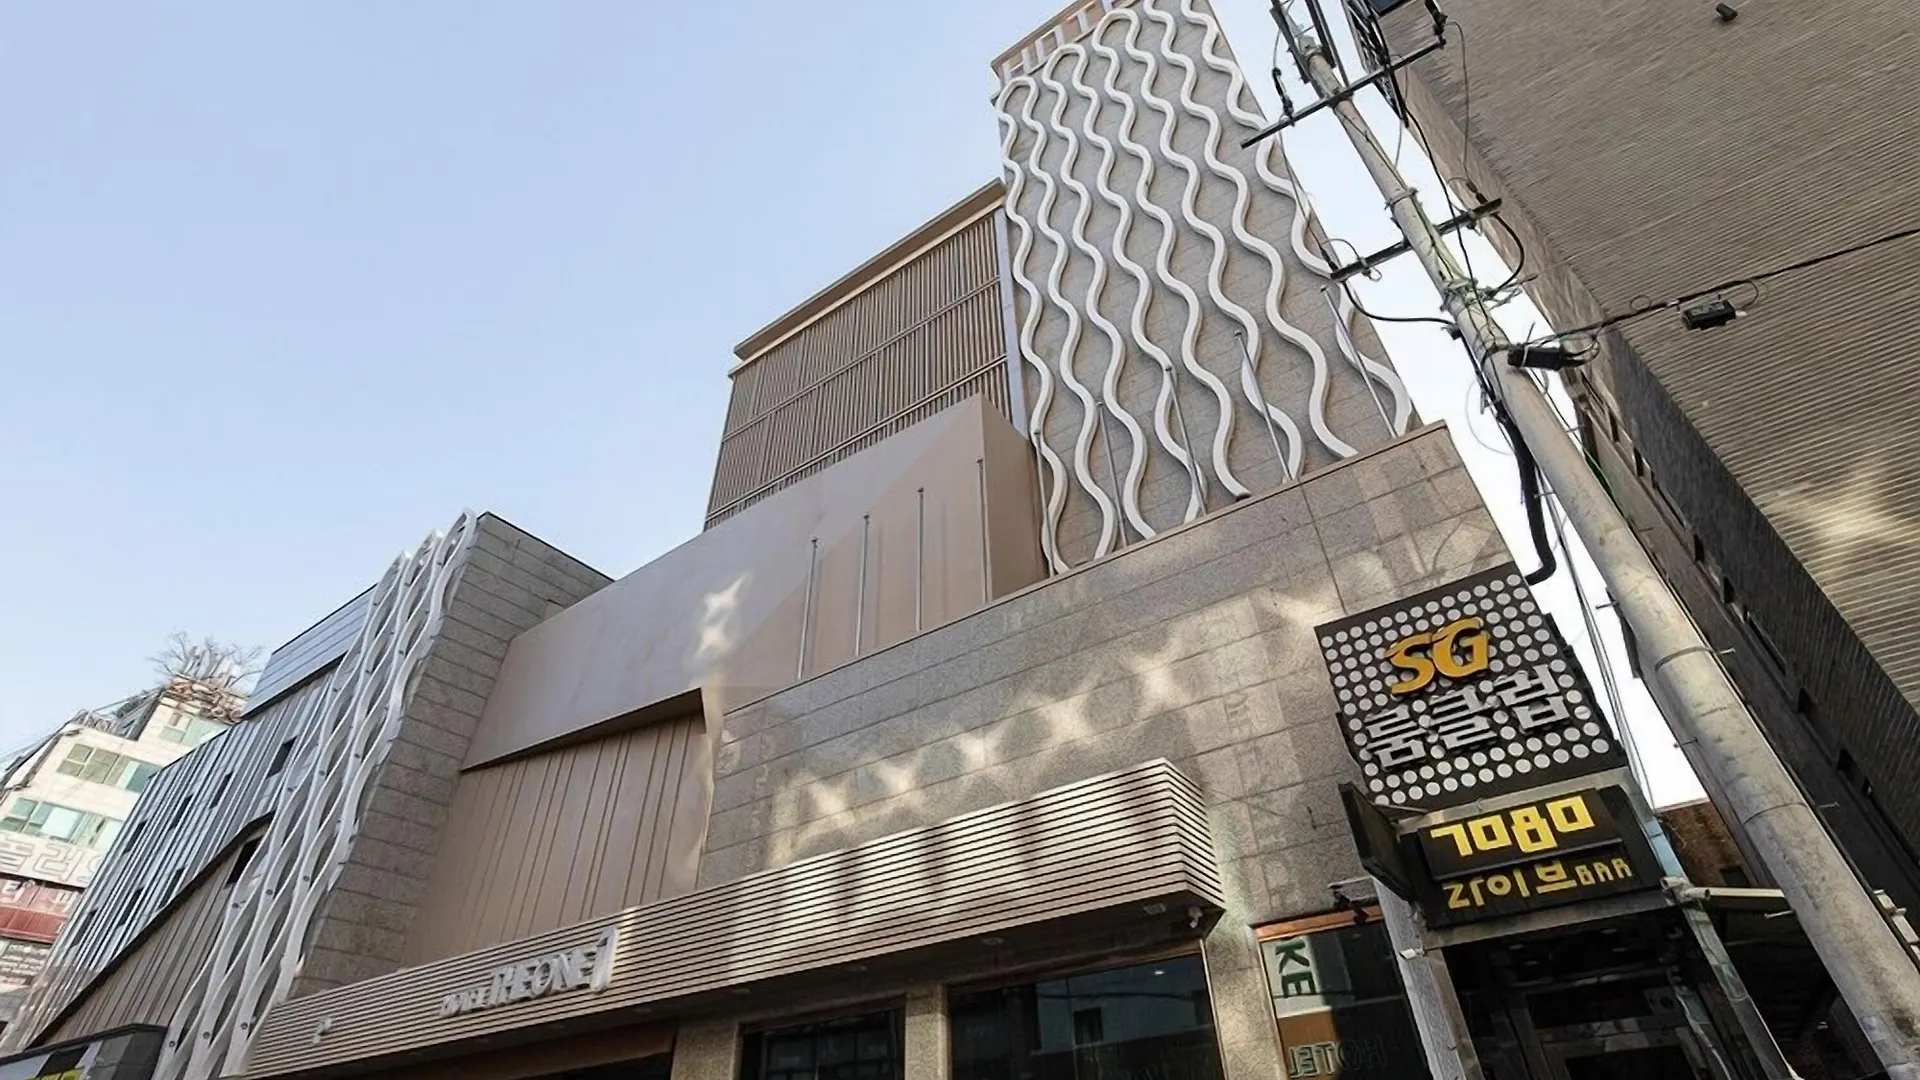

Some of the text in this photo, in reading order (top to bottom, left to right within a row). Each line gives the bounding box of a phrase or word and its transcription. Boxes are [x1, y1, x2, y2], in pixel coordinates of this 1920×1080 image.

[1384, 616, 1491, 696] SG
[1364, 664, 1571, 770] 룸클럽
[1430, 795, 1596, 857] 7080
